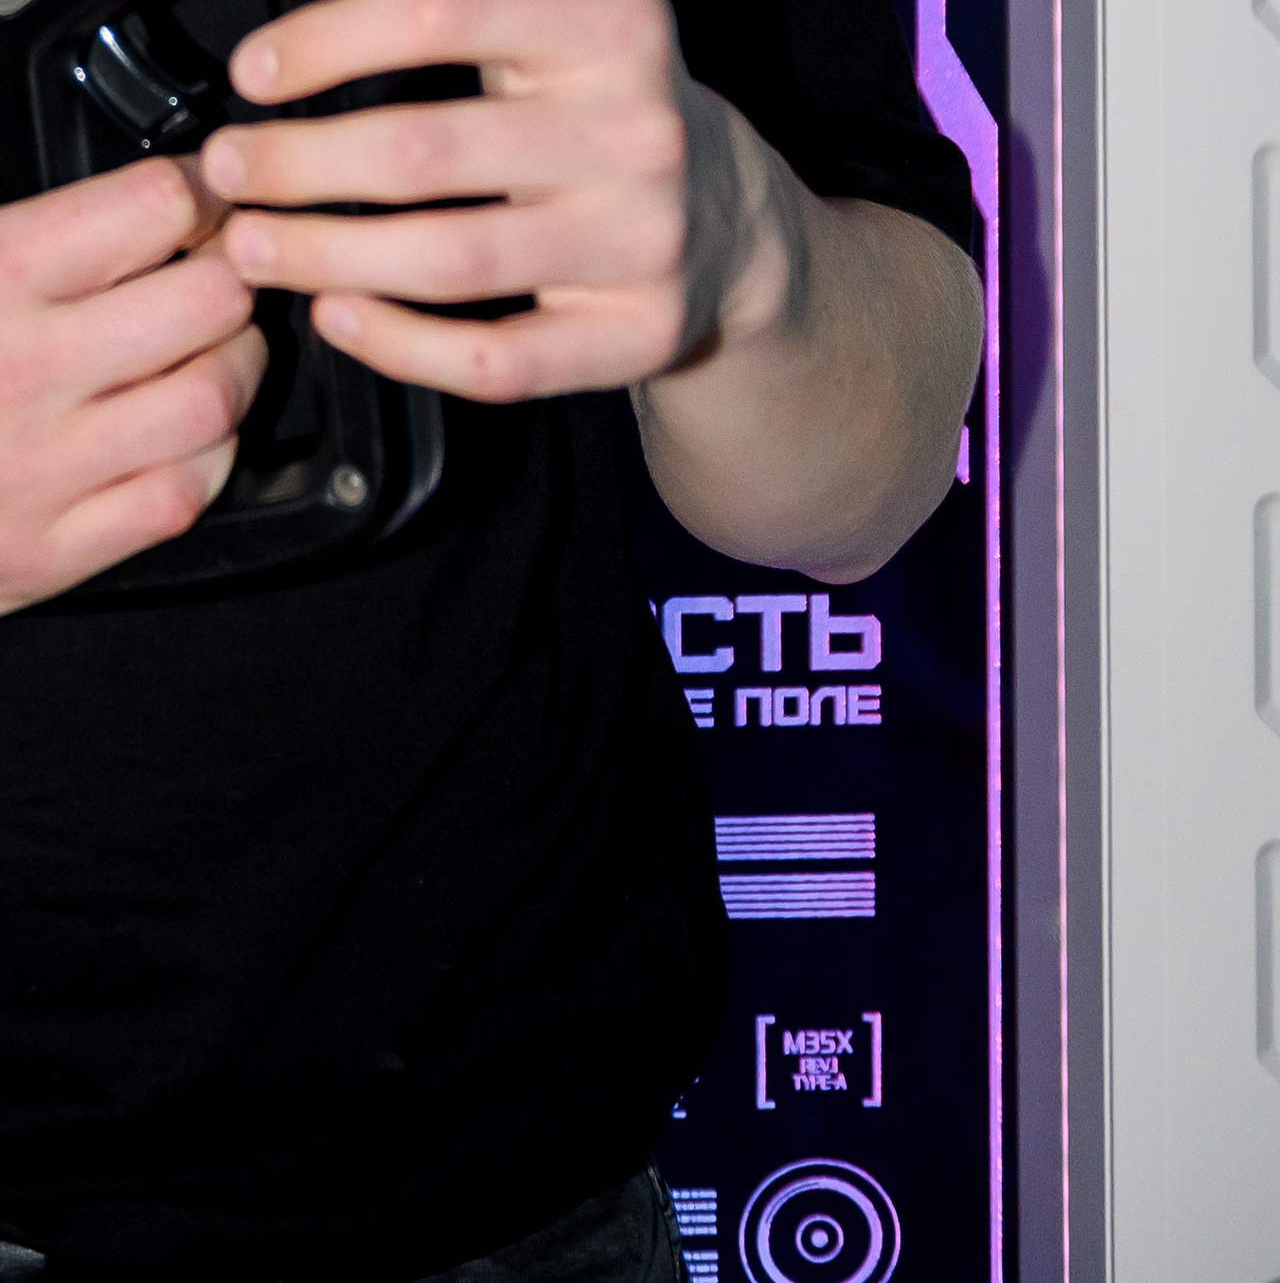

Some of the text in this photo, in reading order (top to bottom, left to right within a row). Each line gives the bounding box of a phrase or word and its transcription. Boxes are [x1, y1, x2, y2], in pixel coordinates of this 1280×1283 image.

[648, 593, 882, 674] СТЬ
[734, 684, 882, 727] ПОЛЕ
[783, 1029, 854, 1055] M35X
